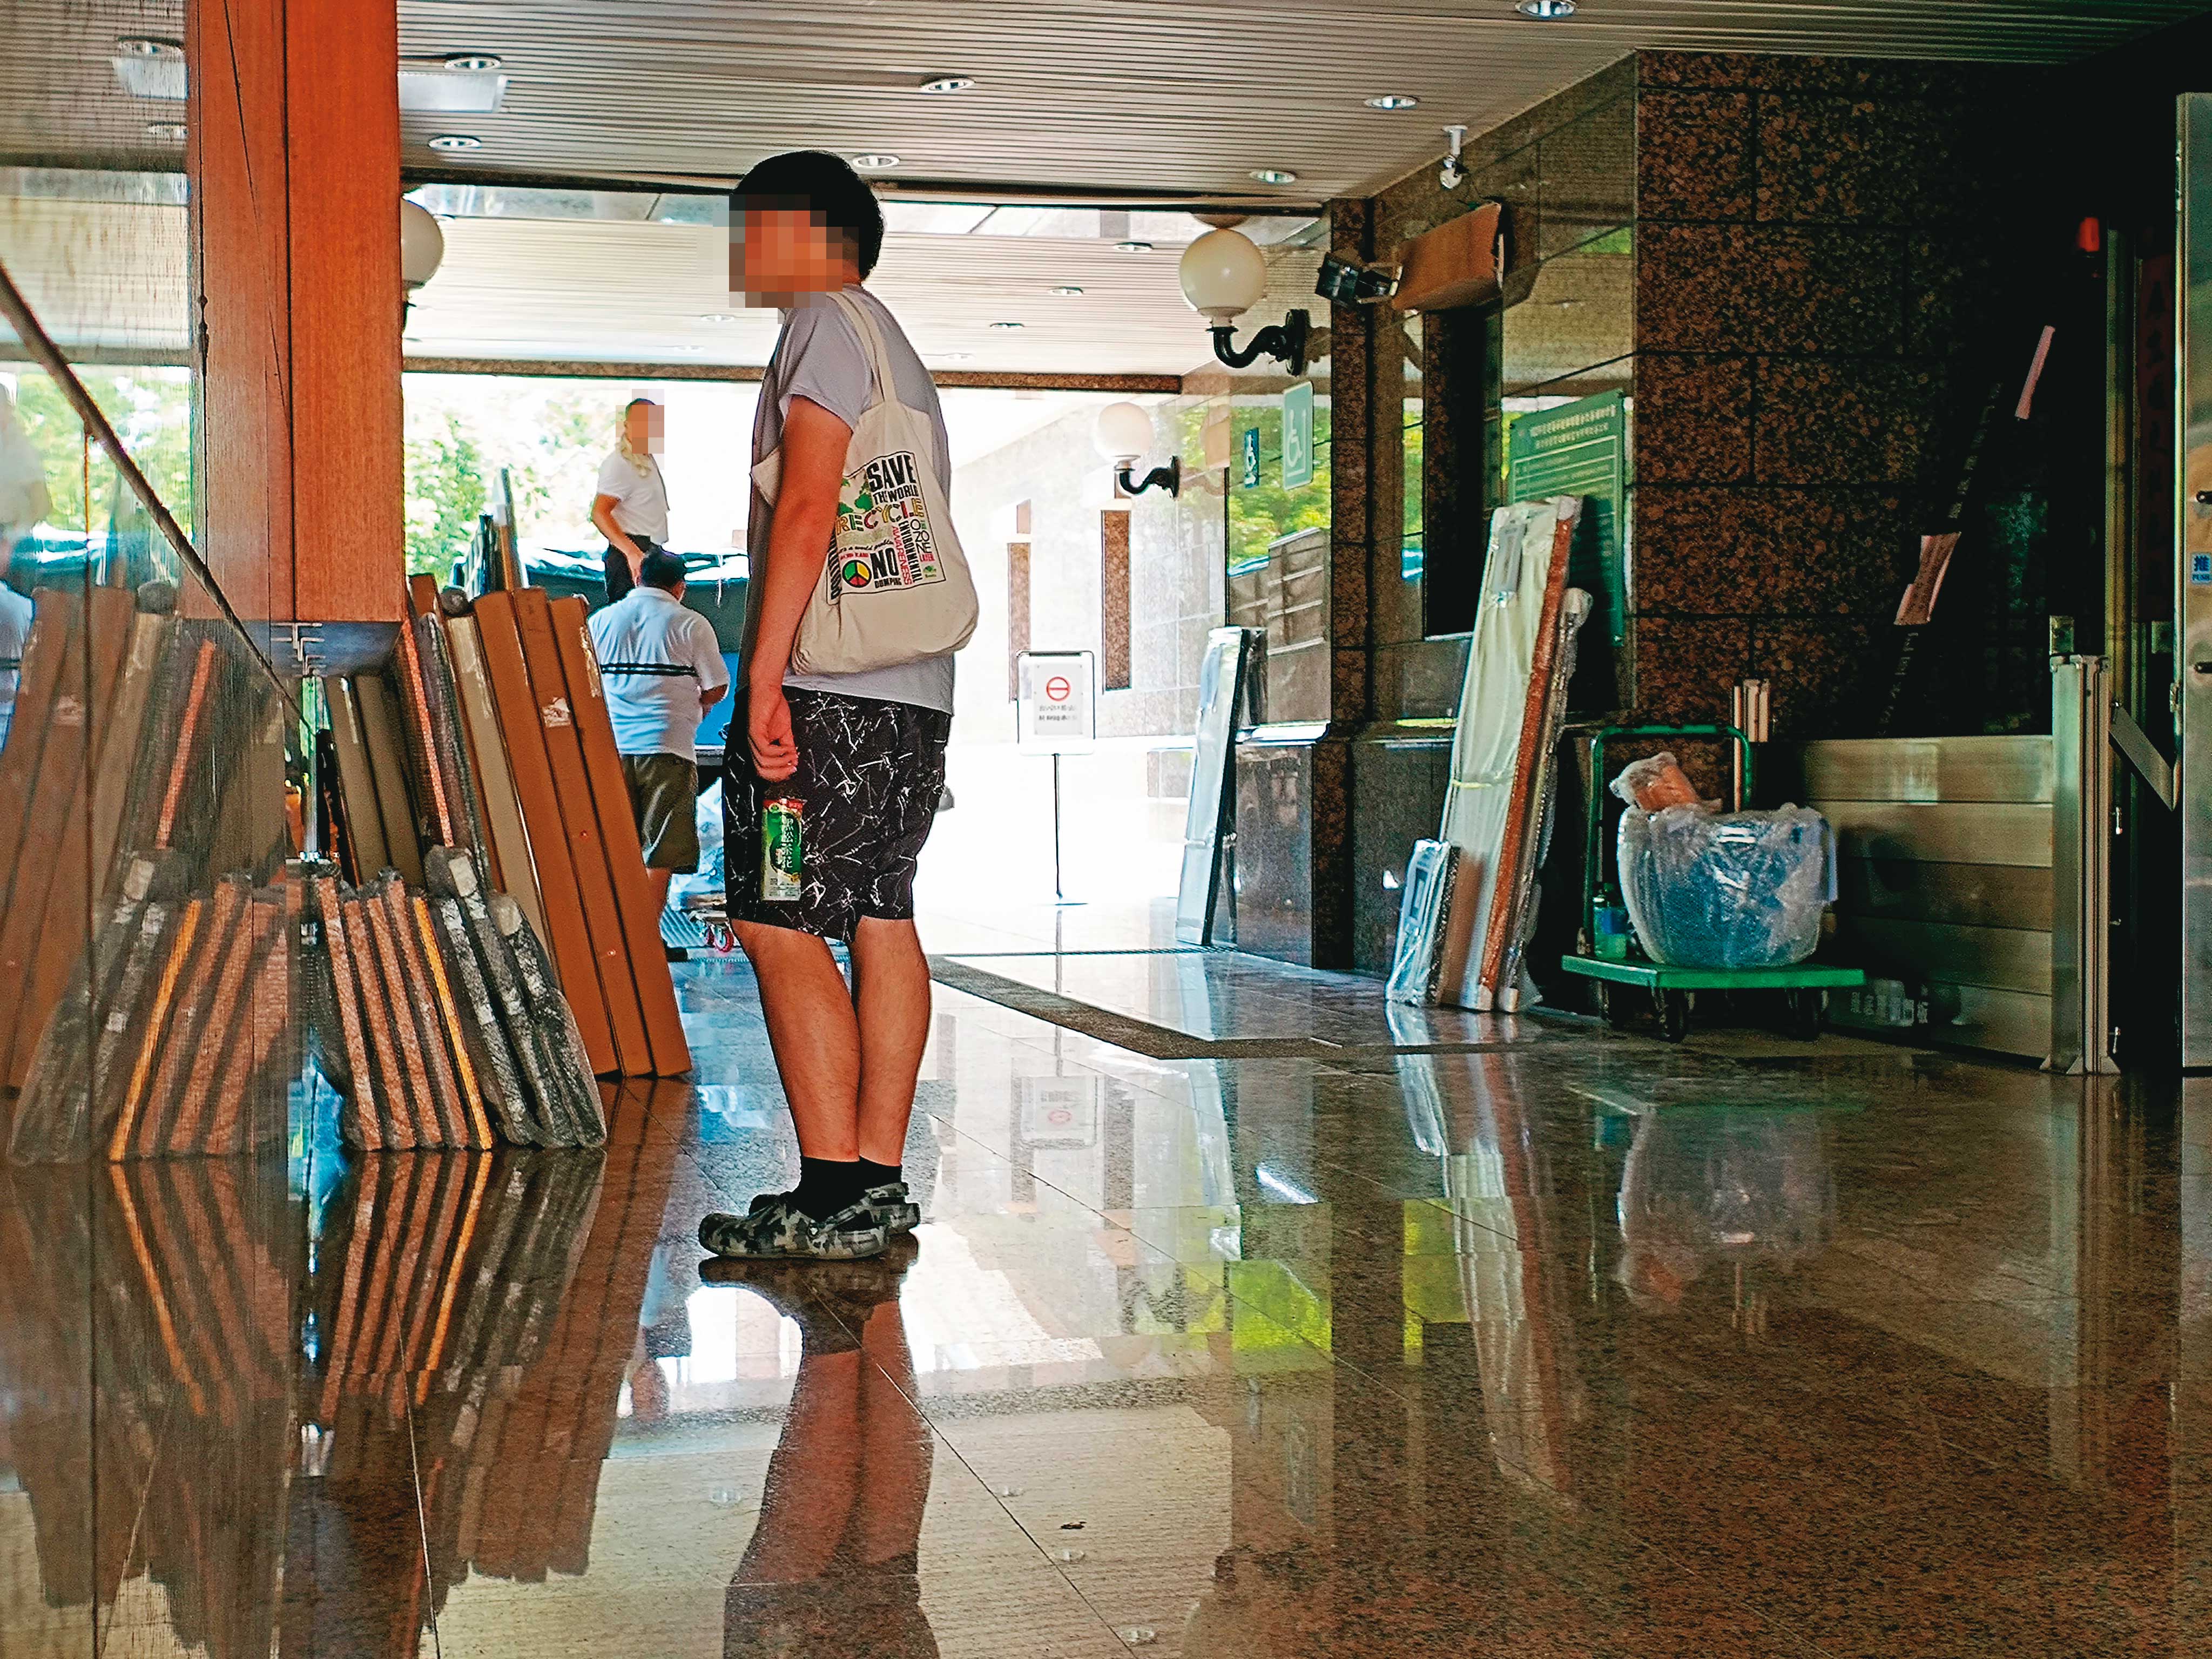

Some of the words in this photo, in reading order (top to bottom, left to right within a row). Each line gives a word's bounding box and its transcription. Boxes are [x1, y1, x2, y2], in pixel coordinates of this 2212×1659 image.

[866, 455, 916, 492] SAVE
[837, 497, 925, 535] RECYCLE
[870, 547, 900, 579] NO
[892, 525, 912, 585] AWARENESS
[898, 520, 922, 583] ENVIRONMENTAL
[2194, 556, 2210, 571] 推
